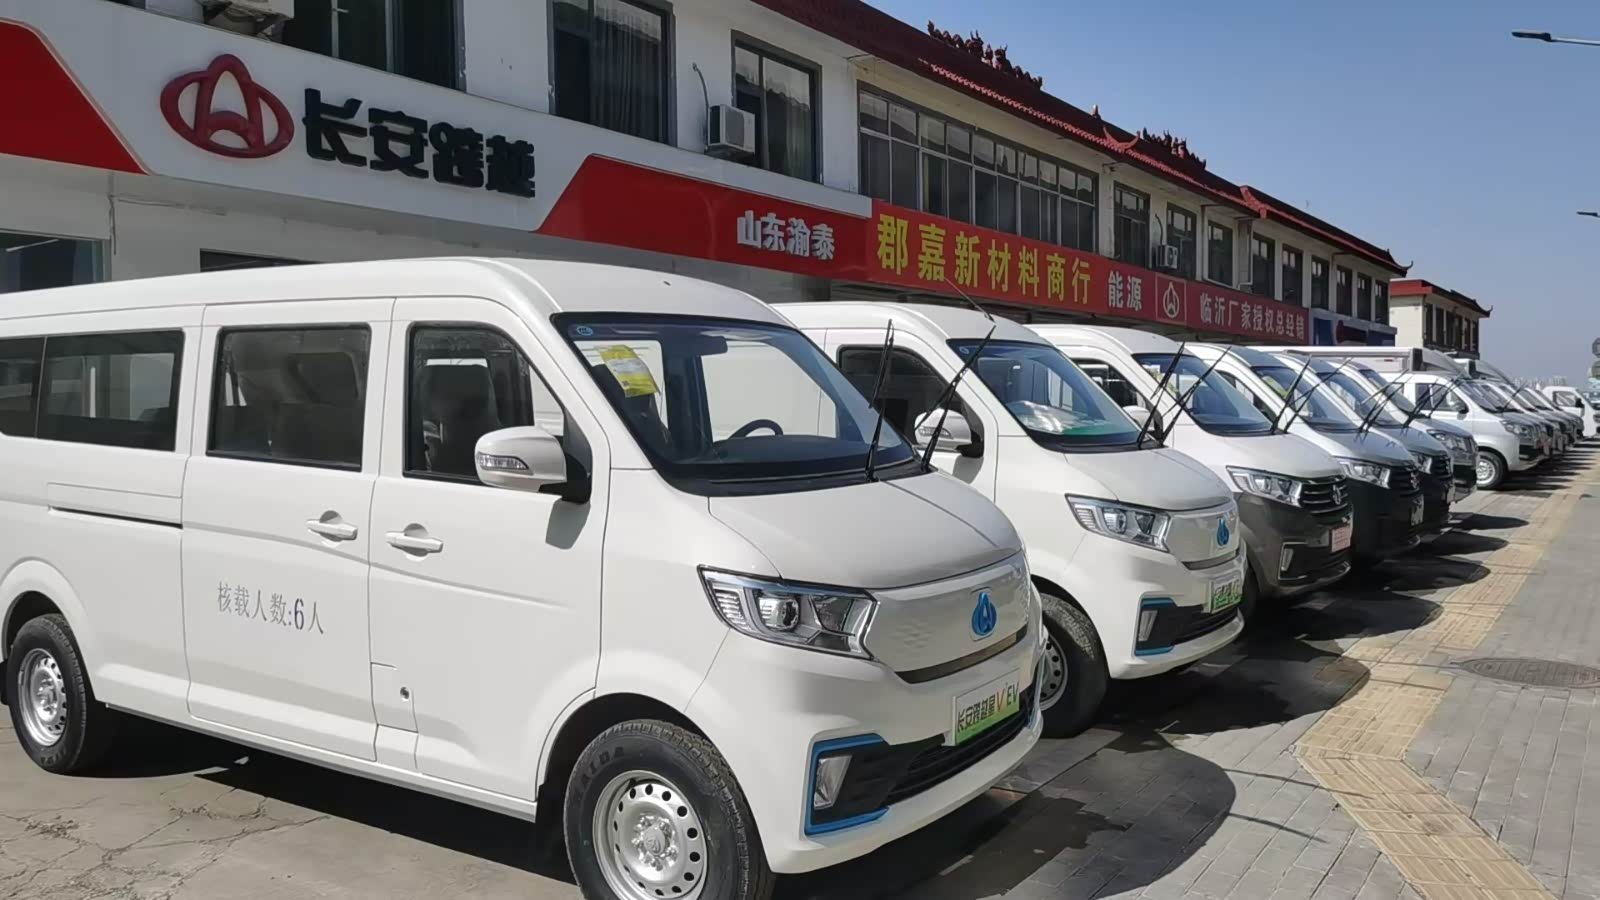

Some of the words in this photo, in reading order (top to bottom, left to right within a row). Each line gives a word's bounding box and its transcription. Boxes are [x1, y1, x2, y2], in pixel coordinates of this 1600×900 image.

[302, 87, 536, 198] 长安跨越
[737, 210, 835, 260] 山东渝泰
[877, 213, 1091, 304] 郡嘉新材料商行
[1108, 271, 1142, 311] 能源
[1200, 292, 1305, 340] 临沂厂家授权总经销
[217, 580, 324, 634] 核载人数:6人
